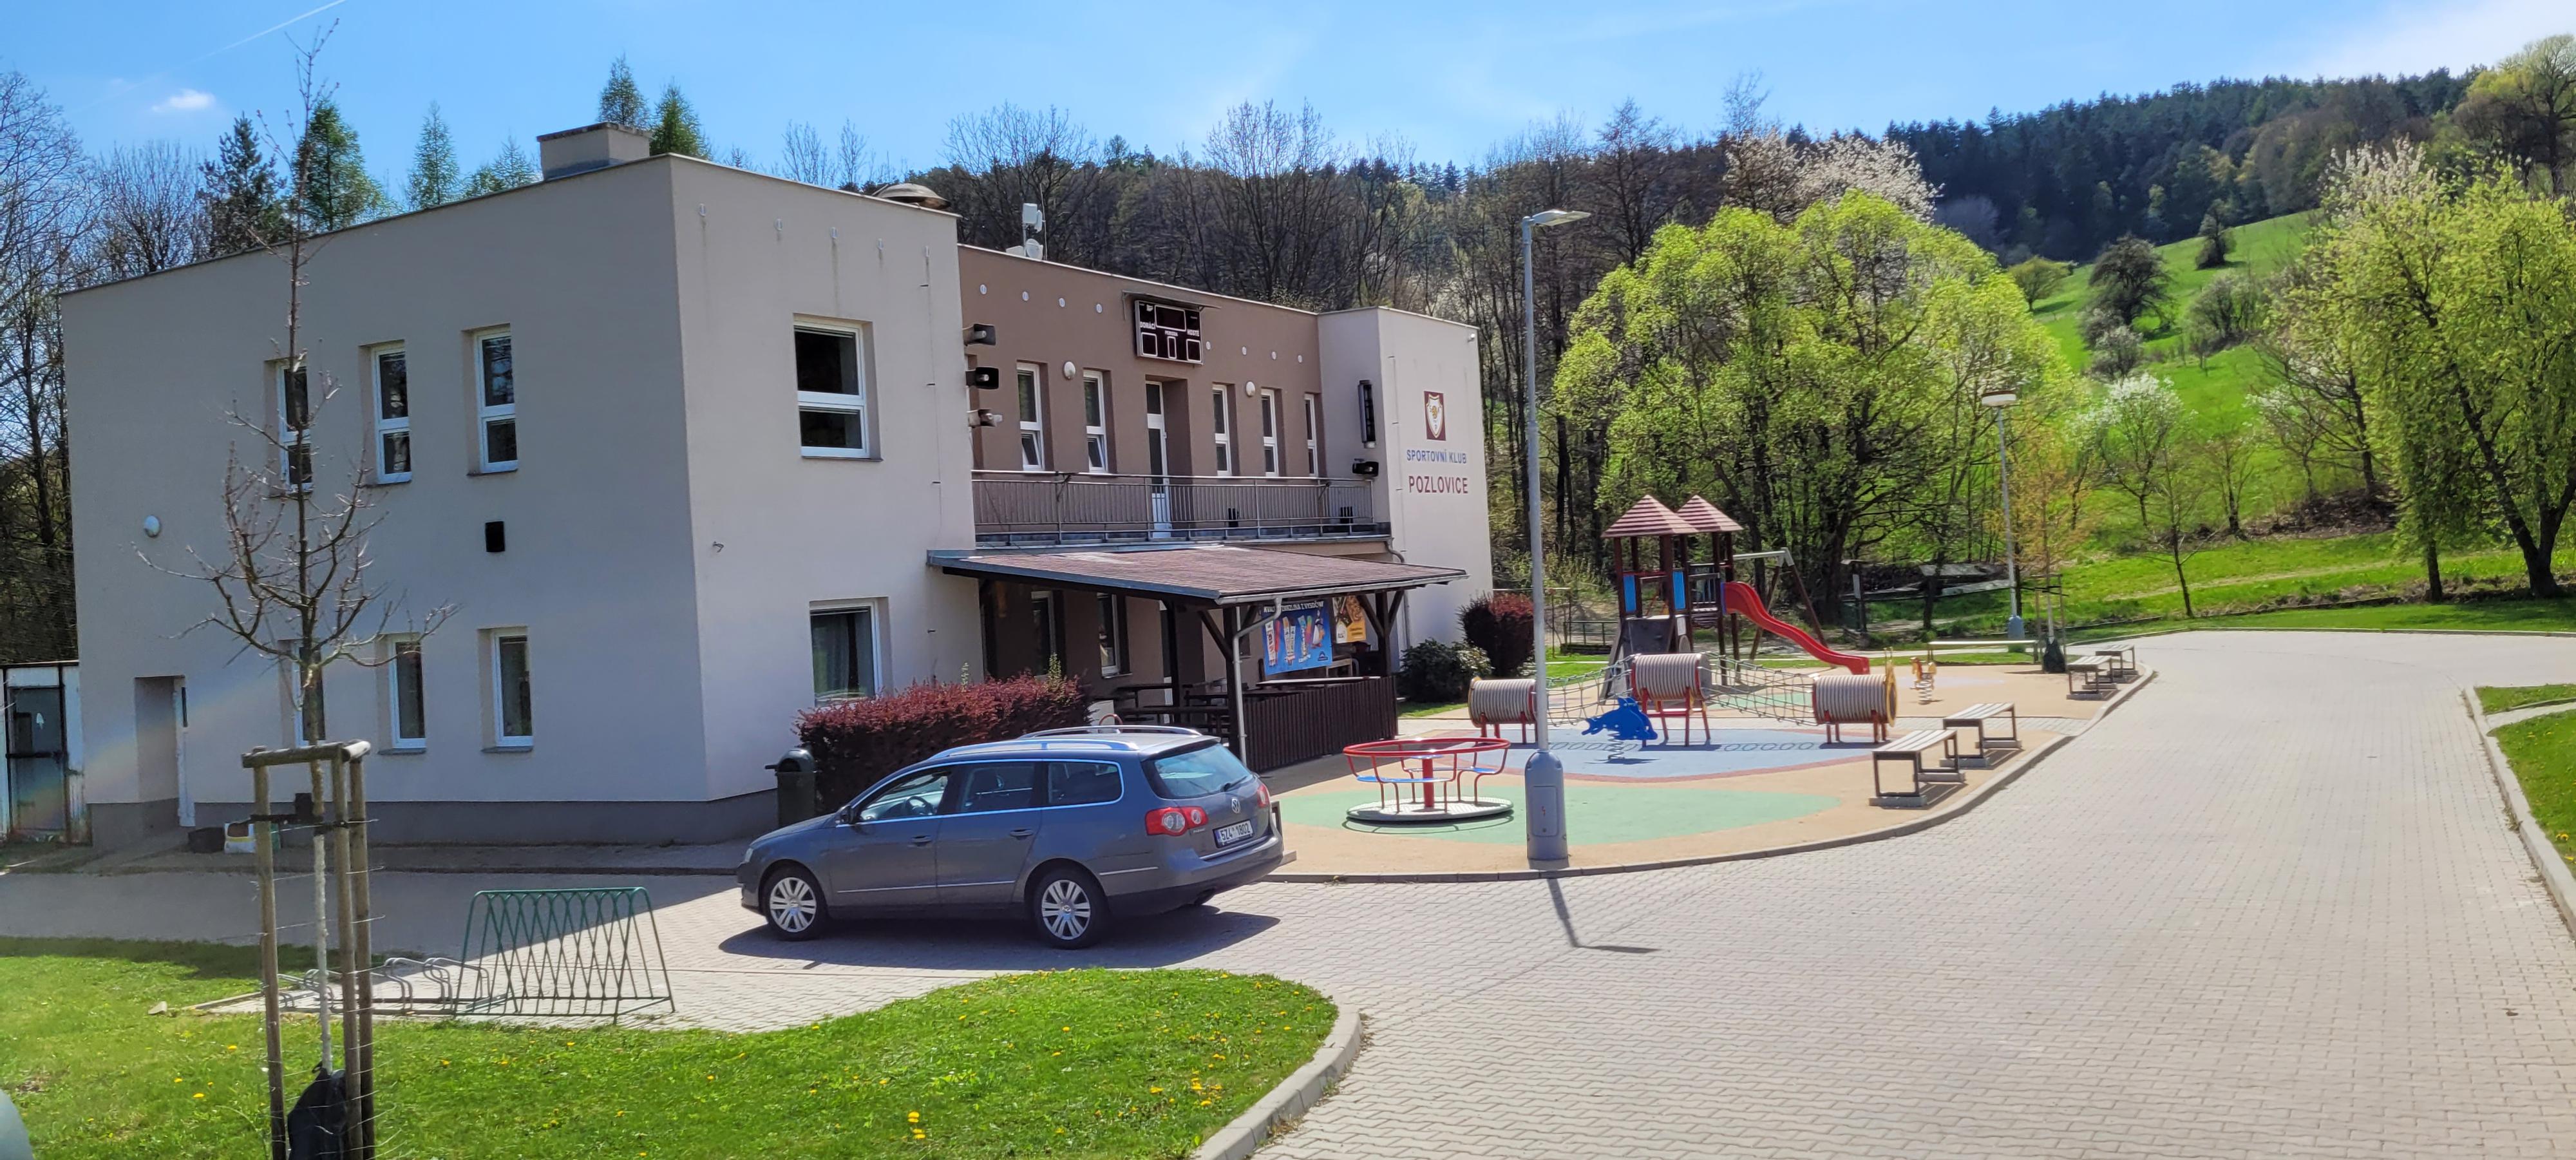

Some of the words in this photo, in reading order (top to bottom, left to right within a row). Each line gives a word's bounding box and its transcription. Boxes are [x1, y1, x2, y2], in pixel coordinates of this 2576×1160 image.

[1406, 449, 1448, 462] SPORTOVNÍ
[1449, 452, 1467, 464] KLUB
[1408, 475, 1468, 494] POZLOVICE
[1220, 828, 1233, 841] 5Z4
[1236, 822, 1251, 835] 1802
